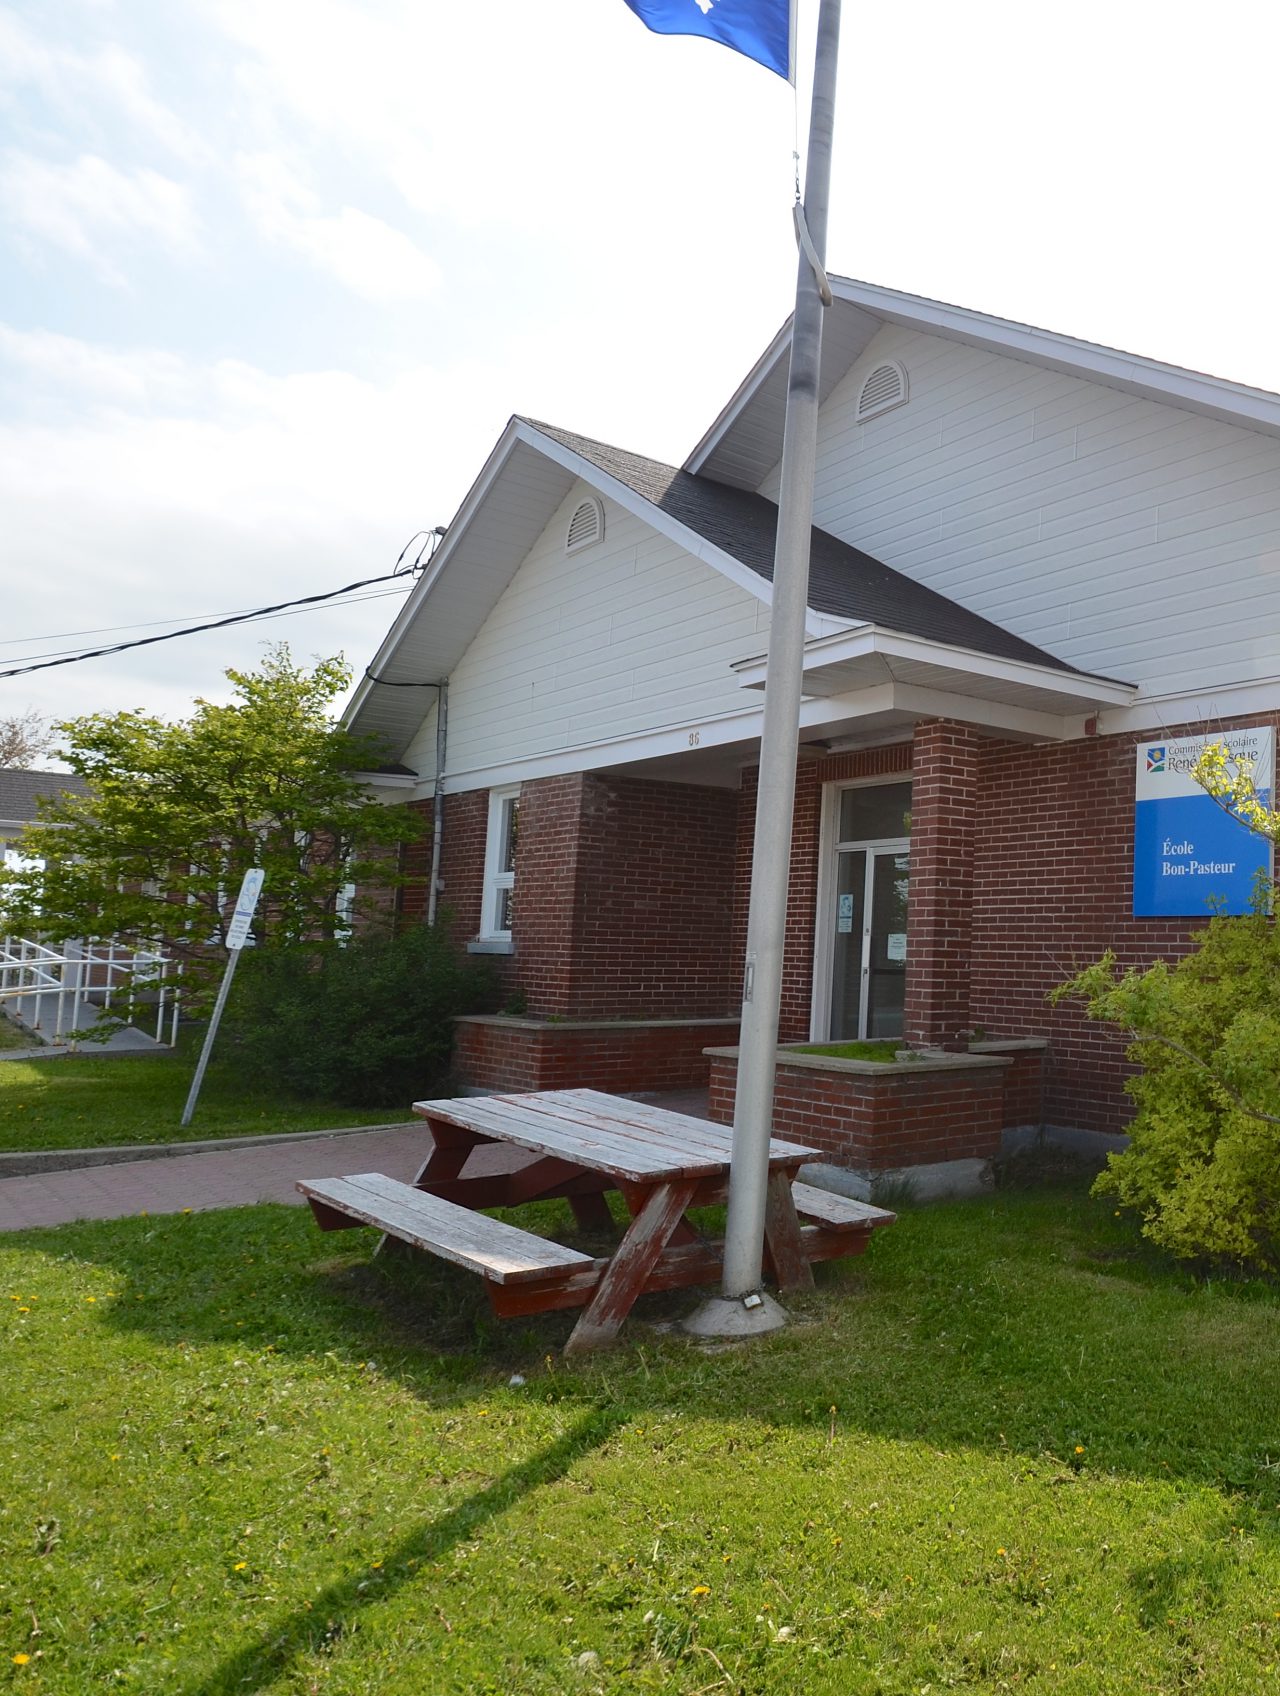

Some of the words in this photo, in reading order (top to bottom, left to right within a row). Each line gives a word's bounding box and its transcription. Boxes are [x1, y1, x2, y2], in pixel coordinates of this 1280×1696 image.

[1223, 736, 1258, 749] scolaire
[1162, 837, 1194, 856] École
[1162, 860, 1236, 876] Bon-Pasteur
